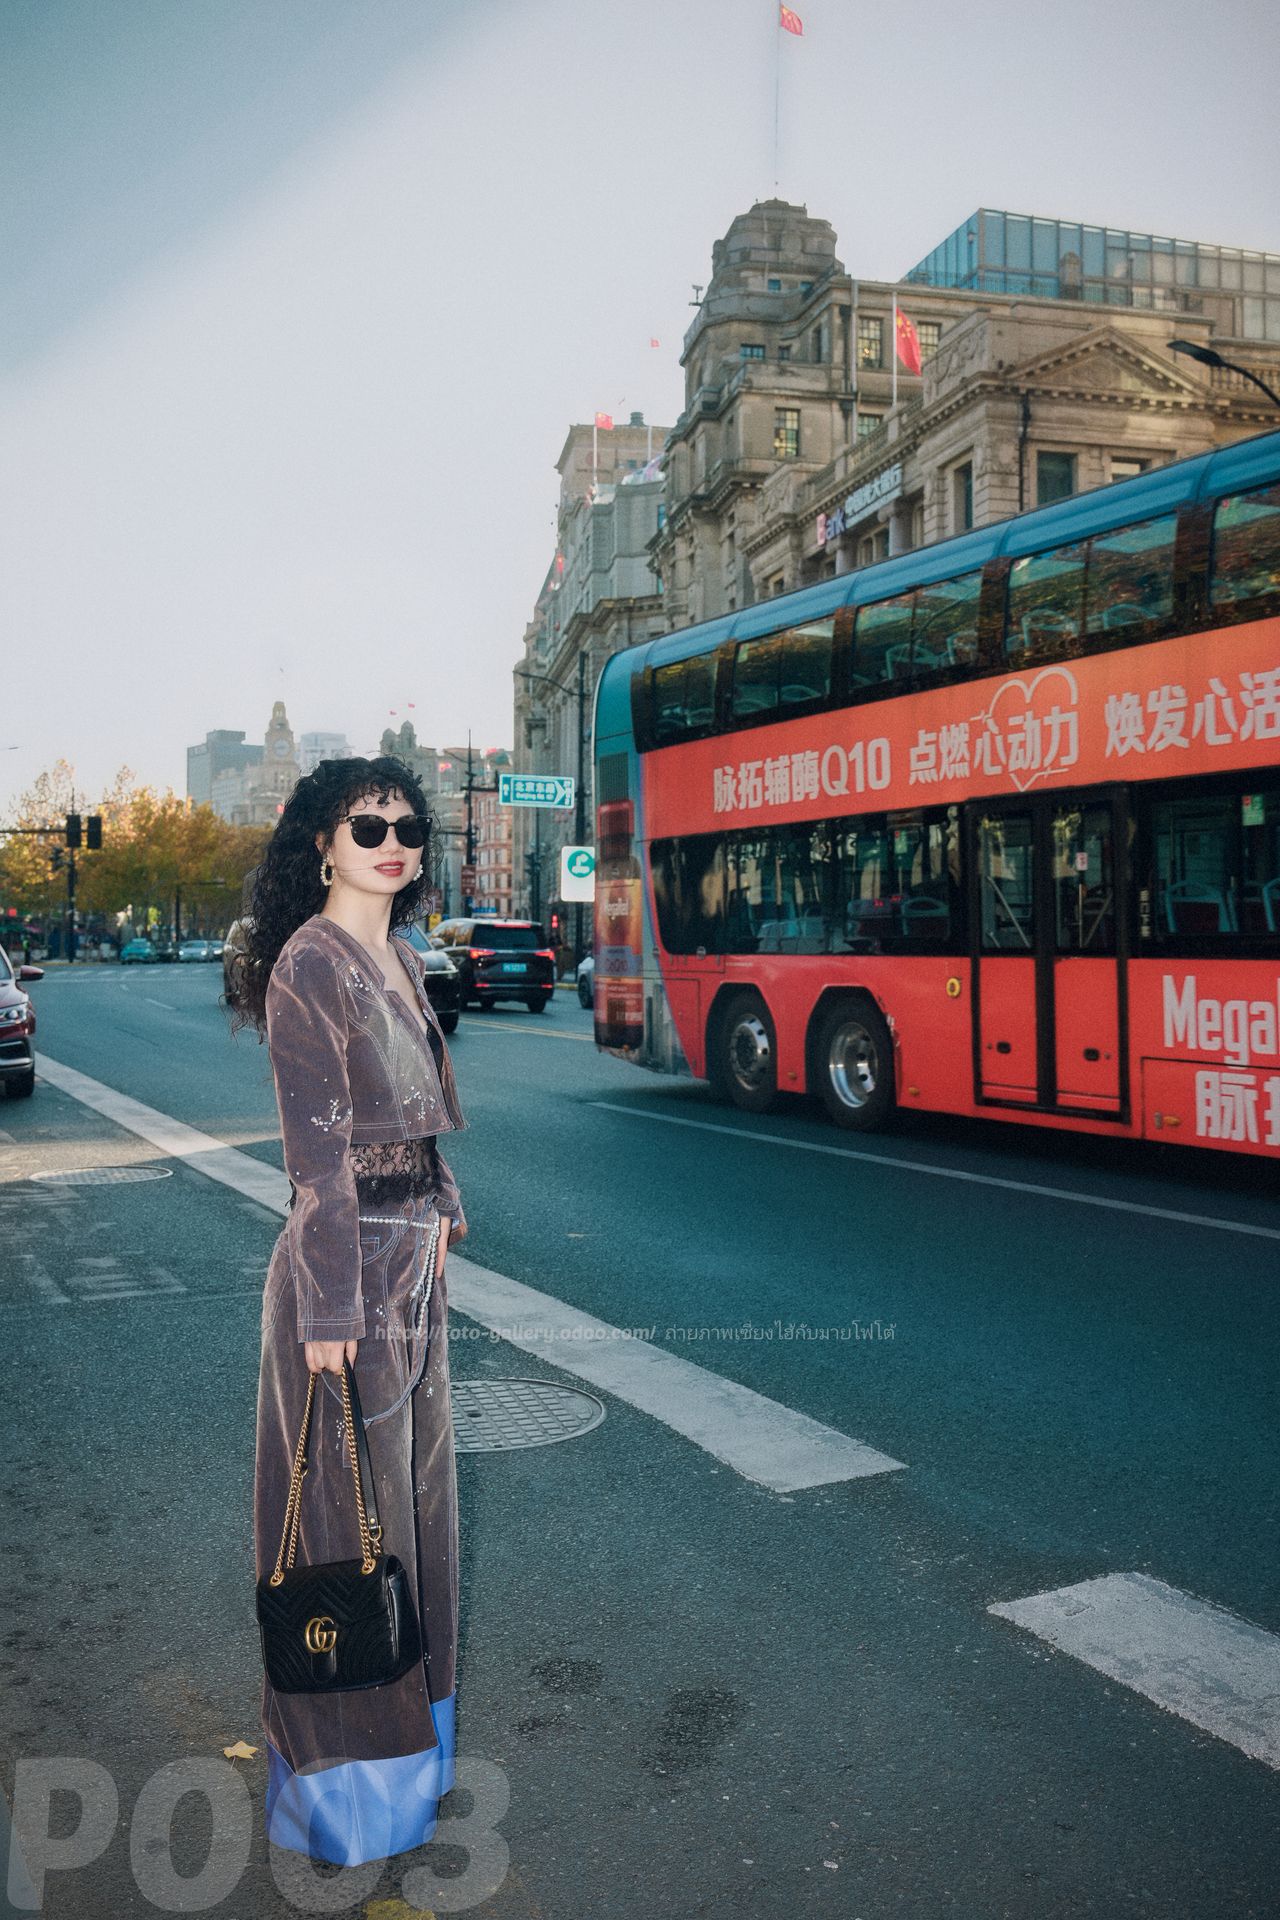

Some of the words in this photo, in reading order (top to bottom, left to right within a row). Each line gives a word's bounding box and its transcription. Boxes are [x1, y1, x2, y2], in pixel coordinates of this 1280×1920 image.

[713, 737, 891, 813] 脉拓辅酶Q10
[908, 705, 1079, 785] 点燃心动力
[1104, 667, 1280, 758] 焕发心活
[1162, 975, 1280, 1070] Mega
[1195, 1070, 1280, 1147] 脉
